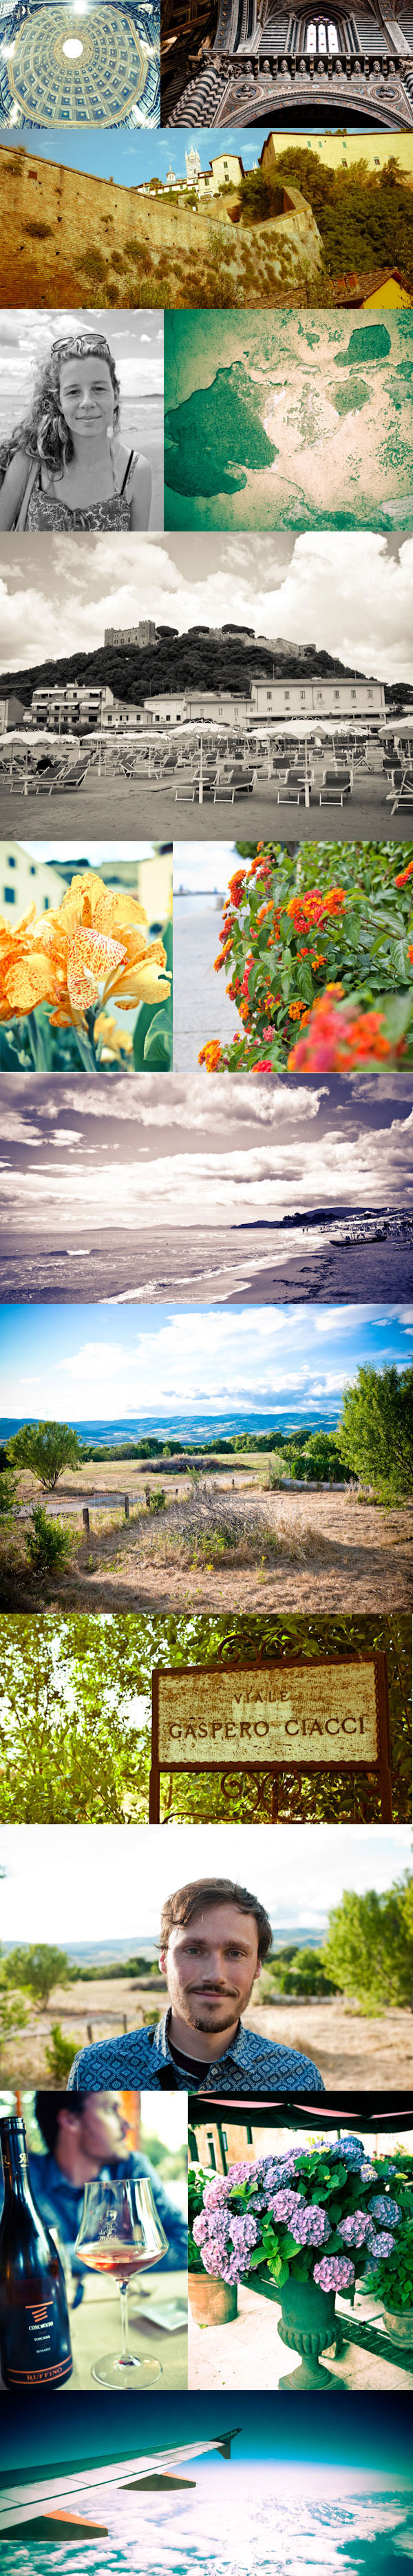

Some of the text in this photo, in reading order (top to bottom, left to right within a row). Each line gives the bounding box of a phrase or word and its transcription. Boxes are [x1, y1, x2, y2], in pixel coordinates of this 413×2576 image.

[233, 1691, 290, 1704] VIALE
[169, 1716, 366, 1739] GASPERO CIACCI
[27, 2367, 63, 2380] RUFFINO
